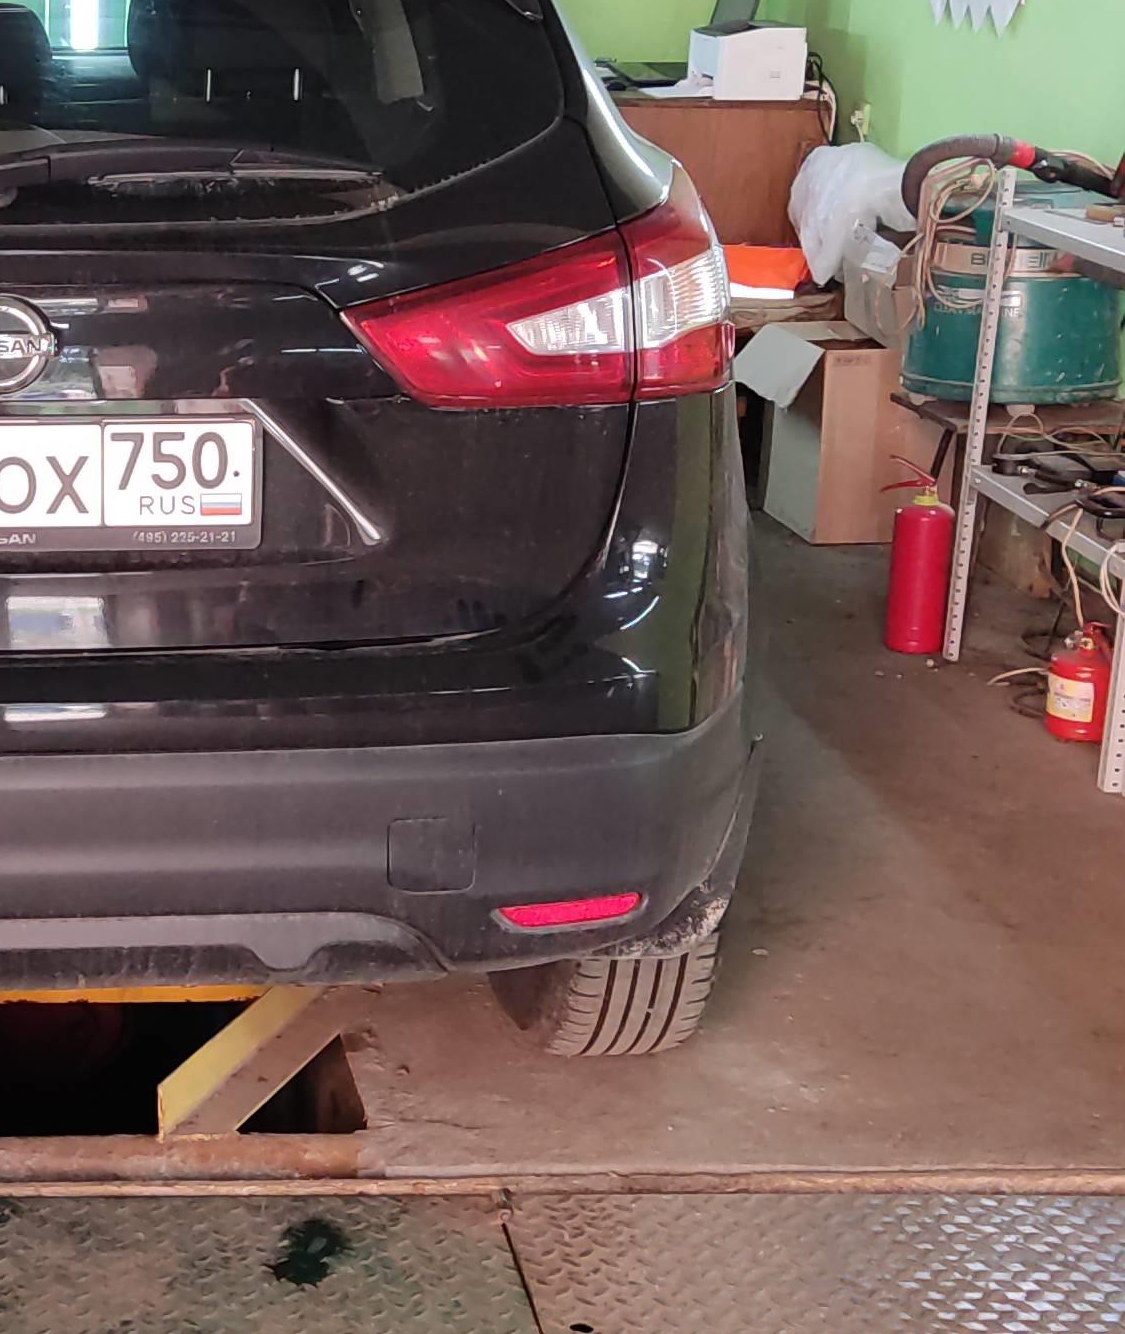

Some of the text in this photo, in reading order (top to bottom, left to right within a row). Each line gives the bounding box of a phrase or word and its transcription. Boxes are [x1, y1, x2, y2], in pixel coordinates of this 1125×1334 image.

[110, 430, 229, 489] 750
[138, 493, 197, 517] RUS
[132, 529, 236, 544] (495) 225-21-21
